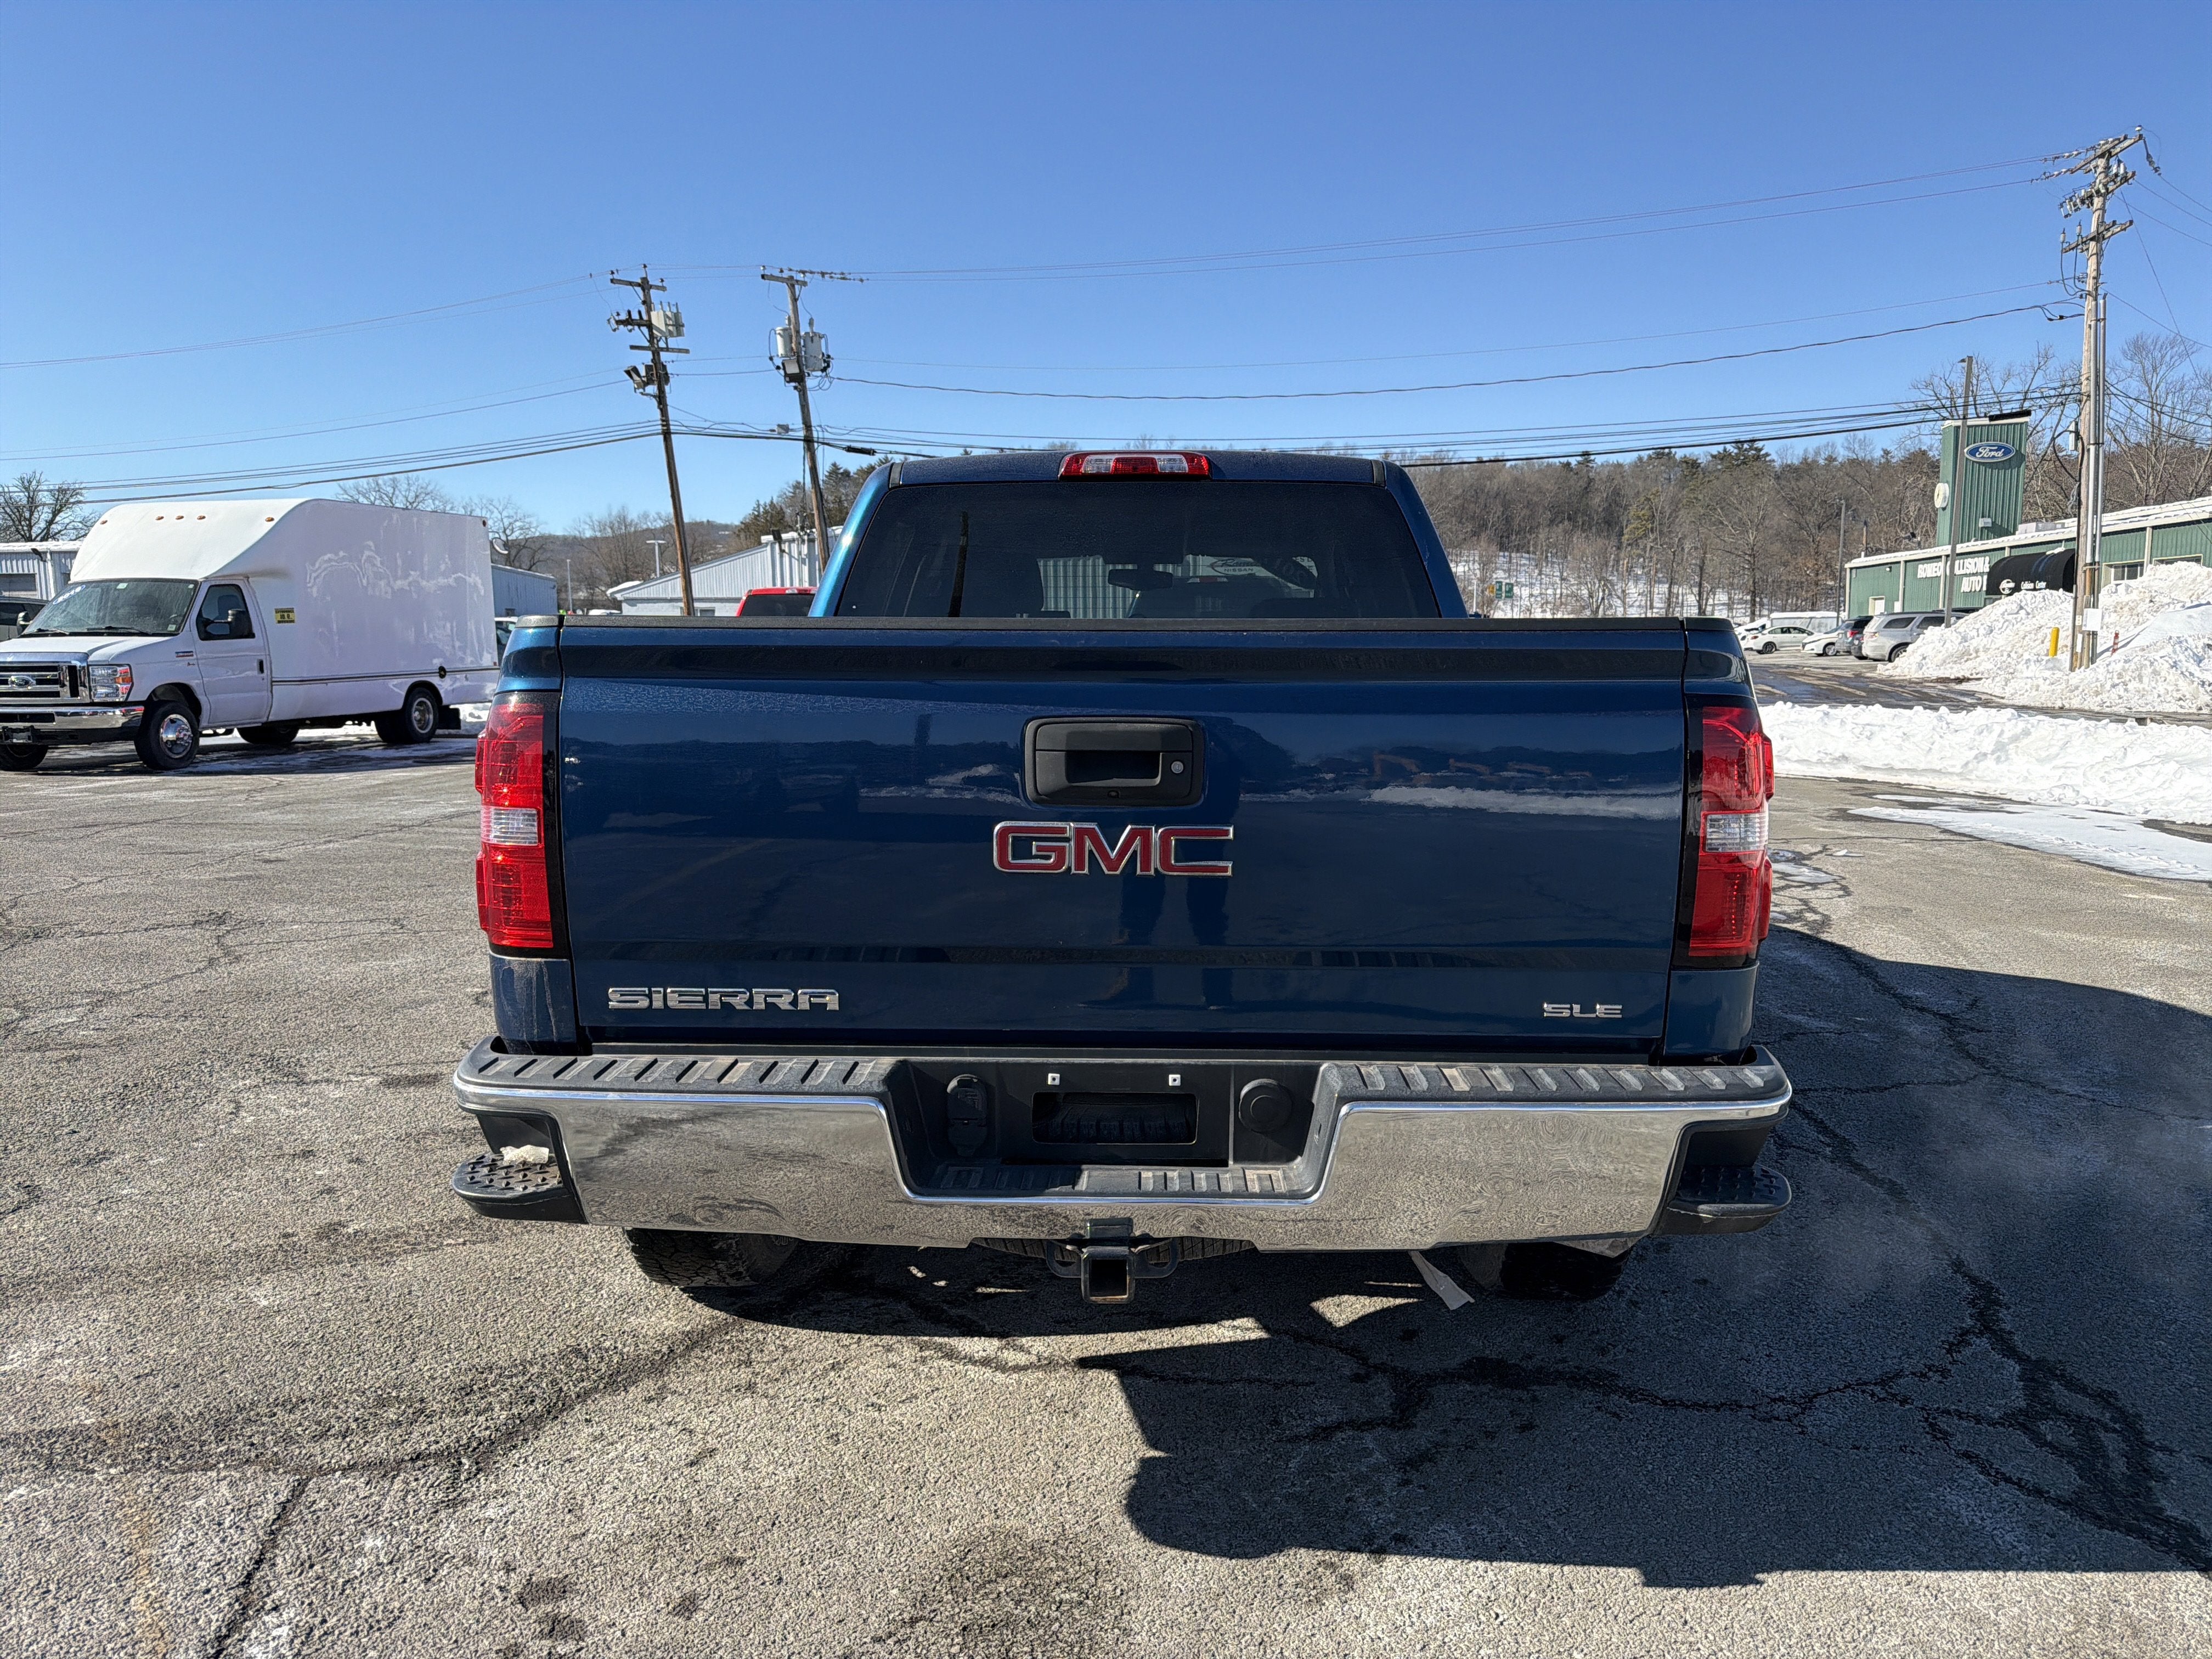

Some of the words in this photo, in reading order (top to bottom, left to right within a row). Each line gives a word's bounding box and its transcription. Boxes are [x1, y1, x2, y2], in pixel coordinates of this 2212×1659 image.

[1976, 447, 2005, 457] Ford
[1917, 562, 1942, 578] ROMEO
[1946, 557, 1984, 575] CLLISION
[1961, 575, 1982, 592] AUTO
[993, 821, 1234, 876] GMC
[608, 988, 839, 1010] SIERRA
[1543, 1002, 1622, 1018] SLE
